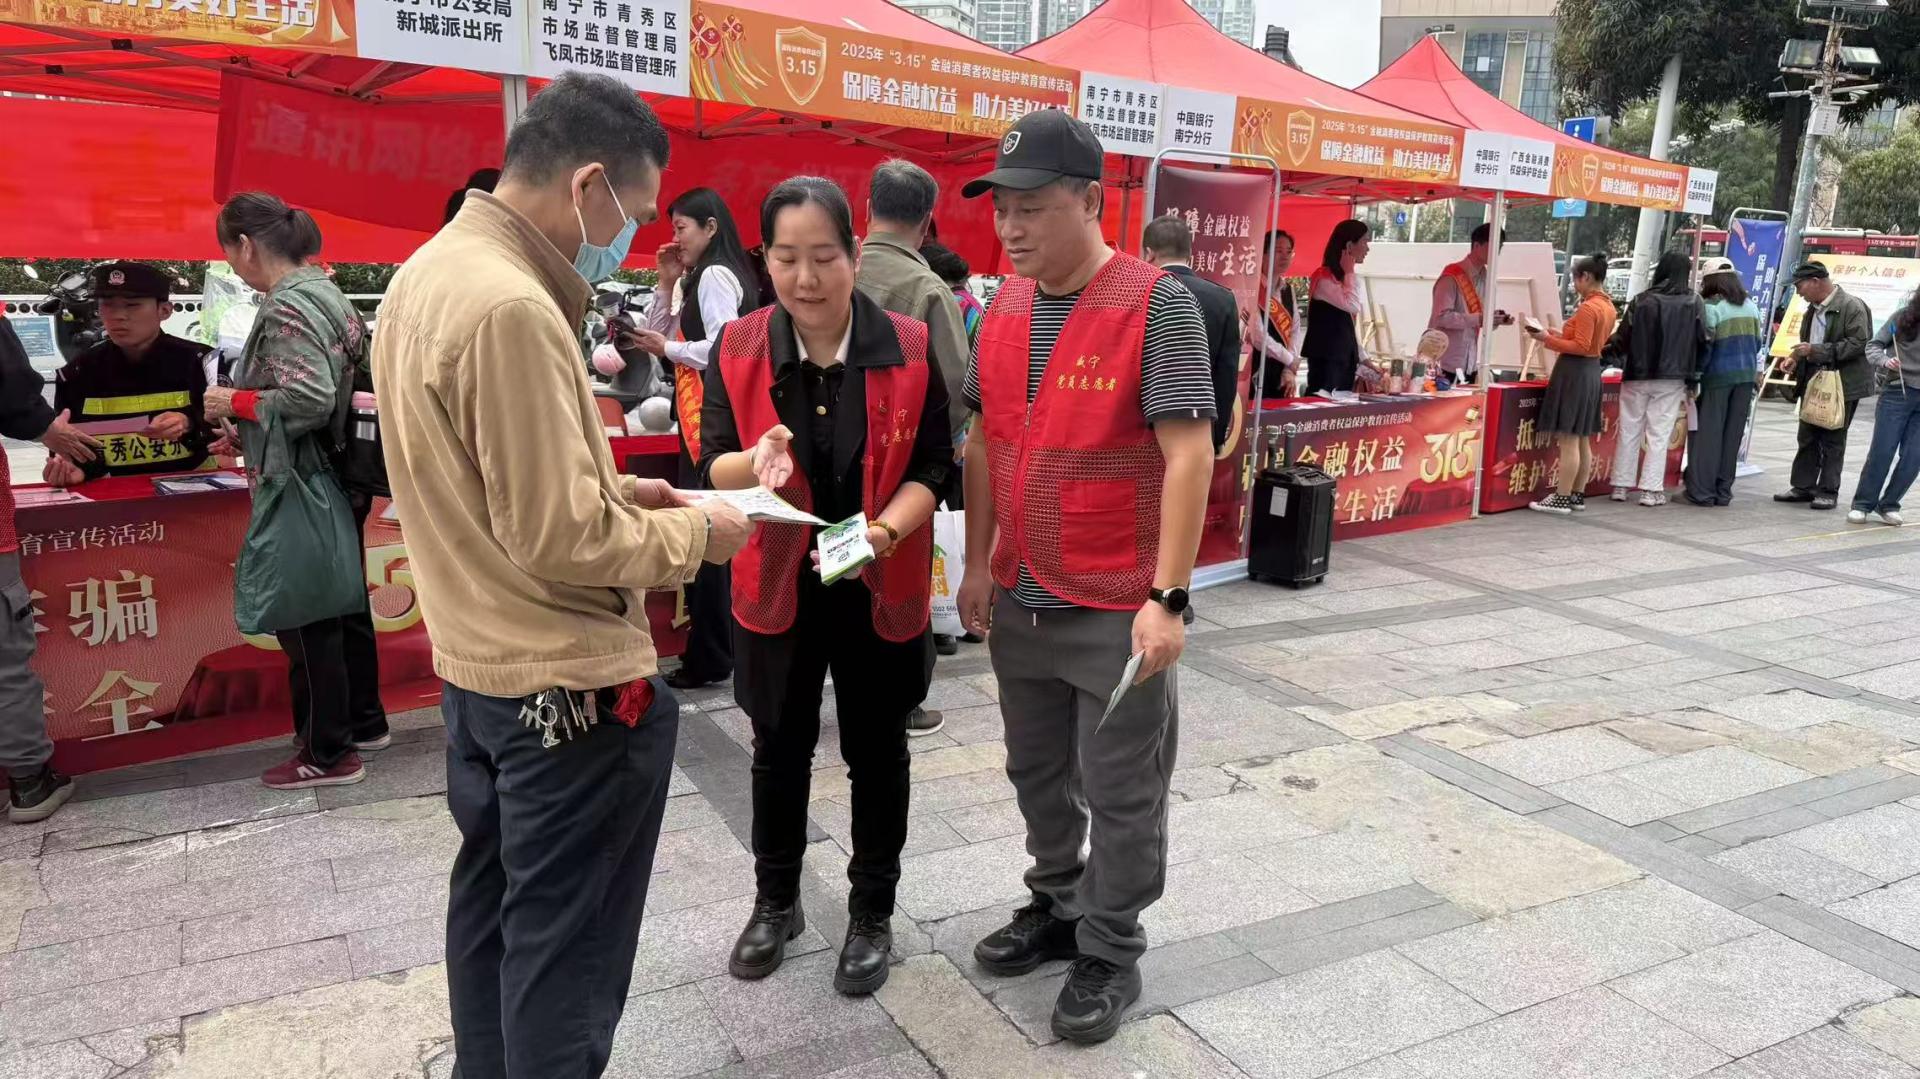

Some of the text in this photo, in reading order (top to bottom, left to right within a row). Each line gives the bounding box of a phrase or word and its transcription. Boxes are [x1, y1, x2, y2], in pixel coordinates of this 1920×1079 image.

[397, 9, 503, 42] 新城派出所
[542, 16, 677, 54] 市场监督管理局
[542, 41, 677, 78] 飞凤市场监督管理所
[785, 56, 816, 76] 3.15
[930, 58, 1075, 93] 金融消费者权益保护教育宣传活动
[842, 70, 959, 115] 保障金融权益
[1086, 85, 1158, 109] 南宁市青秀区
[1085, 104, 1156, 127] 市场监督管理局
[1176, 110, 1214, 129] 中国银行
[1174, 128, 1212, 146] 南宁分行
[1290, 131, 1308, 145] 3.15
[1320, 139, 1453, 174] 保障金融权益 助力美好生活
[1476, 149, 1500, 162] 中国银行
[1475, 162, 1499, 176] 南宁分行
[1832, 264, 1907, 279] 保护个人信息
[1056, 373, 1117, 392] 党员志愿者
[1419, 430, 1478, 484] 315
